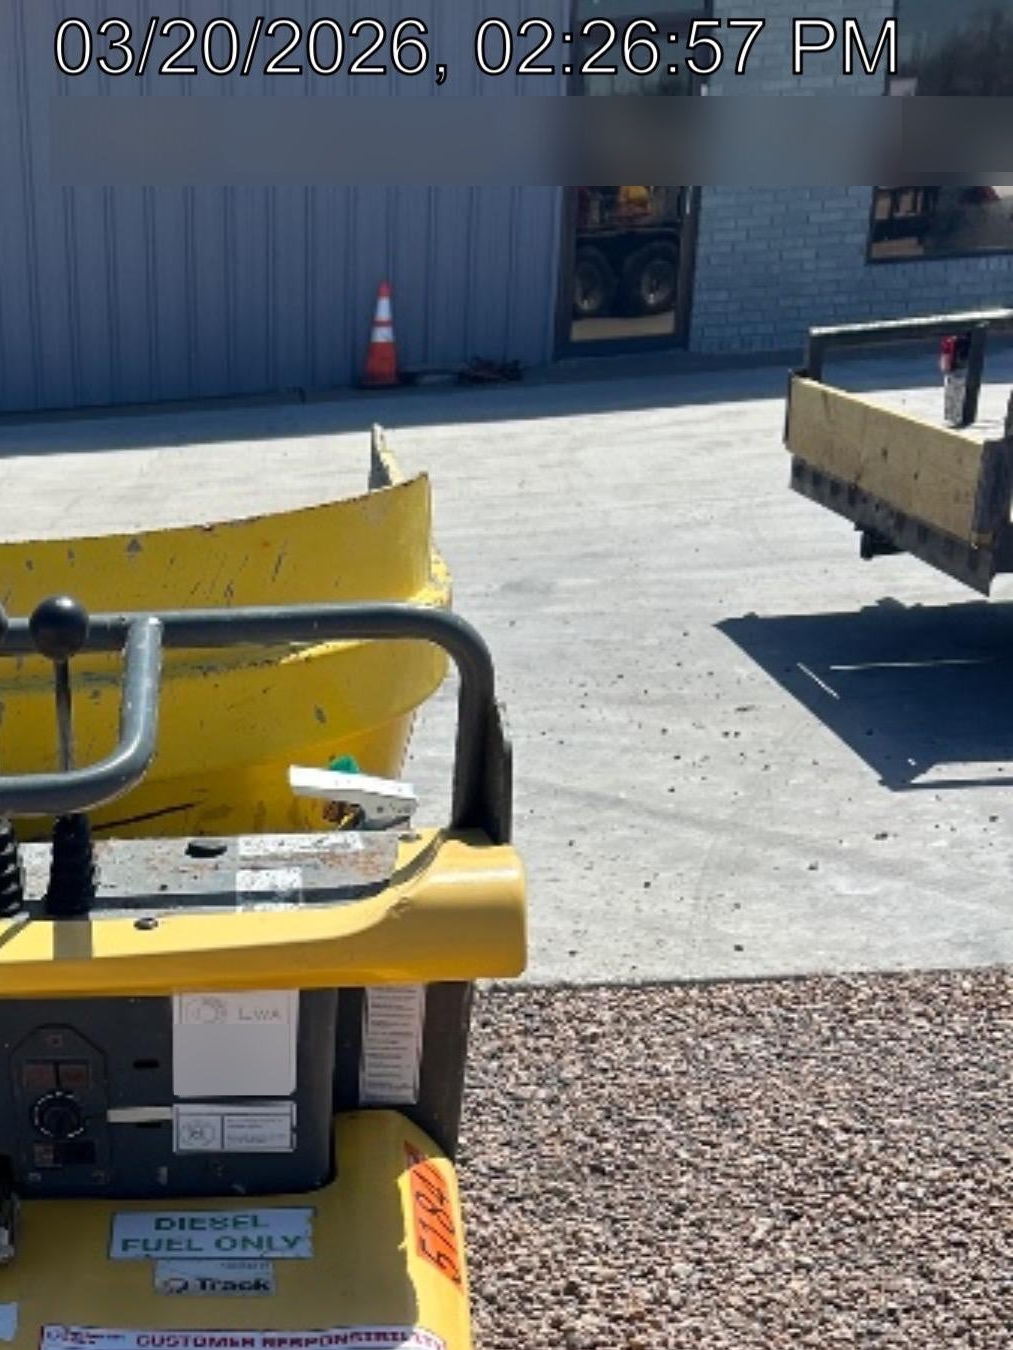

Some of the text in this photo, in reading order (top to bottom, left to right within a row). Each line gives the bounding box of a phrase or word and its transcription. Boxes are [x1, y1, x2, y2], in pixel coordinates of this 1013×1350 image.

[154, 1215, 269, 1231] DIESEL
[121, 1235, 302, 1252] FUEL ONLY
[194, 1277, 271, 1291] Track
[136, 1334, 255, 1349] CUSTOMER
